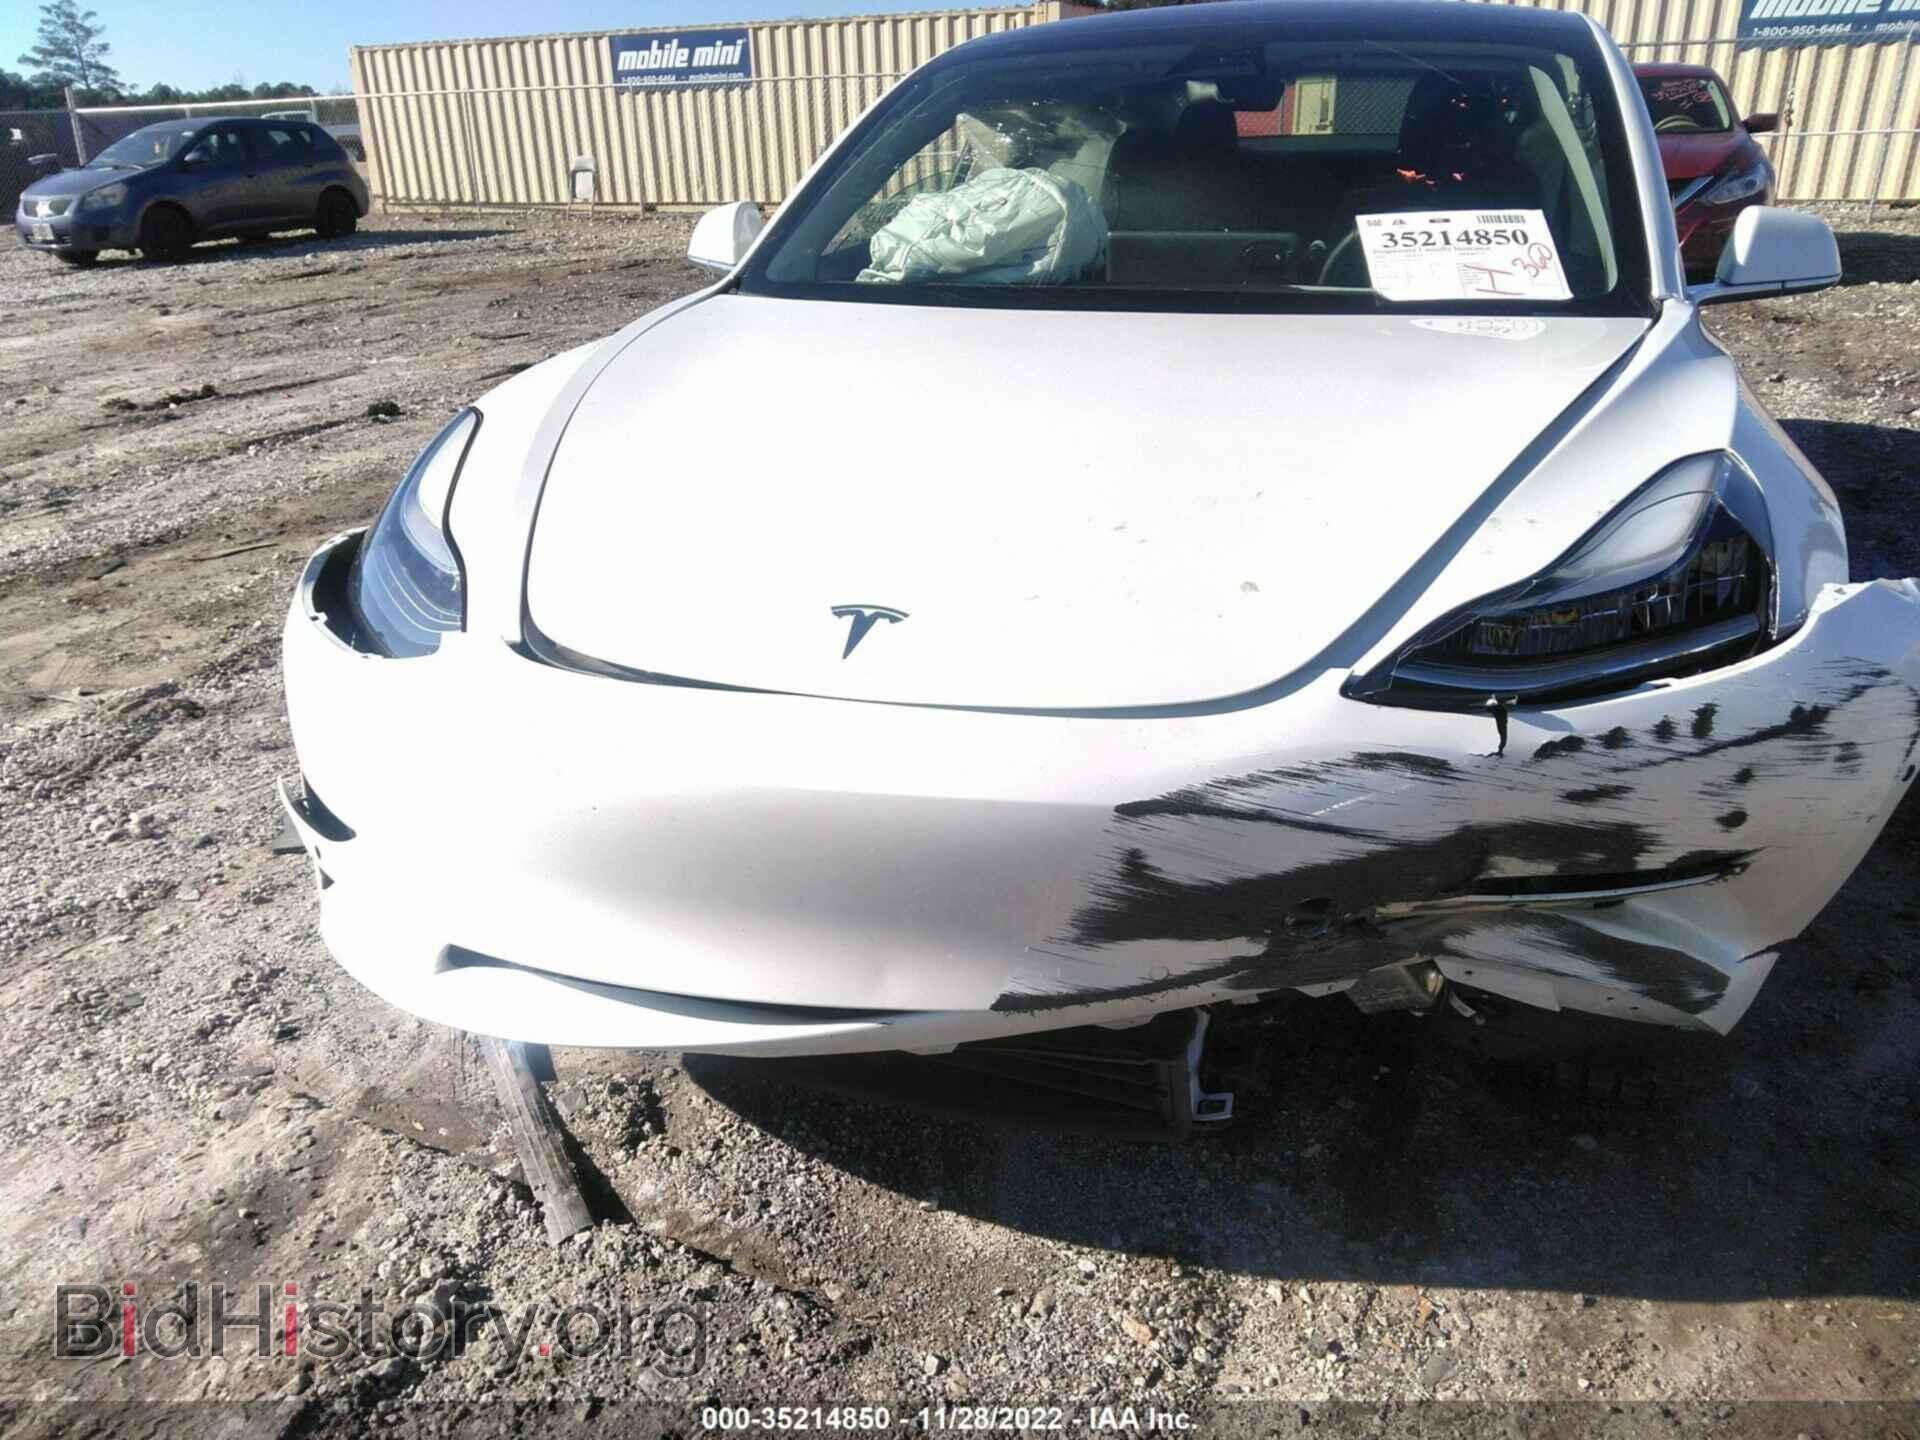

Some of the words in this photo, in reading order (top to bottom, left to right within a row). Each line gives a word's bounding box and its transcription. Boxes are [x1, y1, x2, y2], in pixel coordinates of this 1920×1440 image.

[1752, 23, 1852, 37] 1-800-950-6464
[617, 38, 690, 71] mobile
[692, 39, 743, 67] mini
[1381, 228, 1529, 249] 35214850
